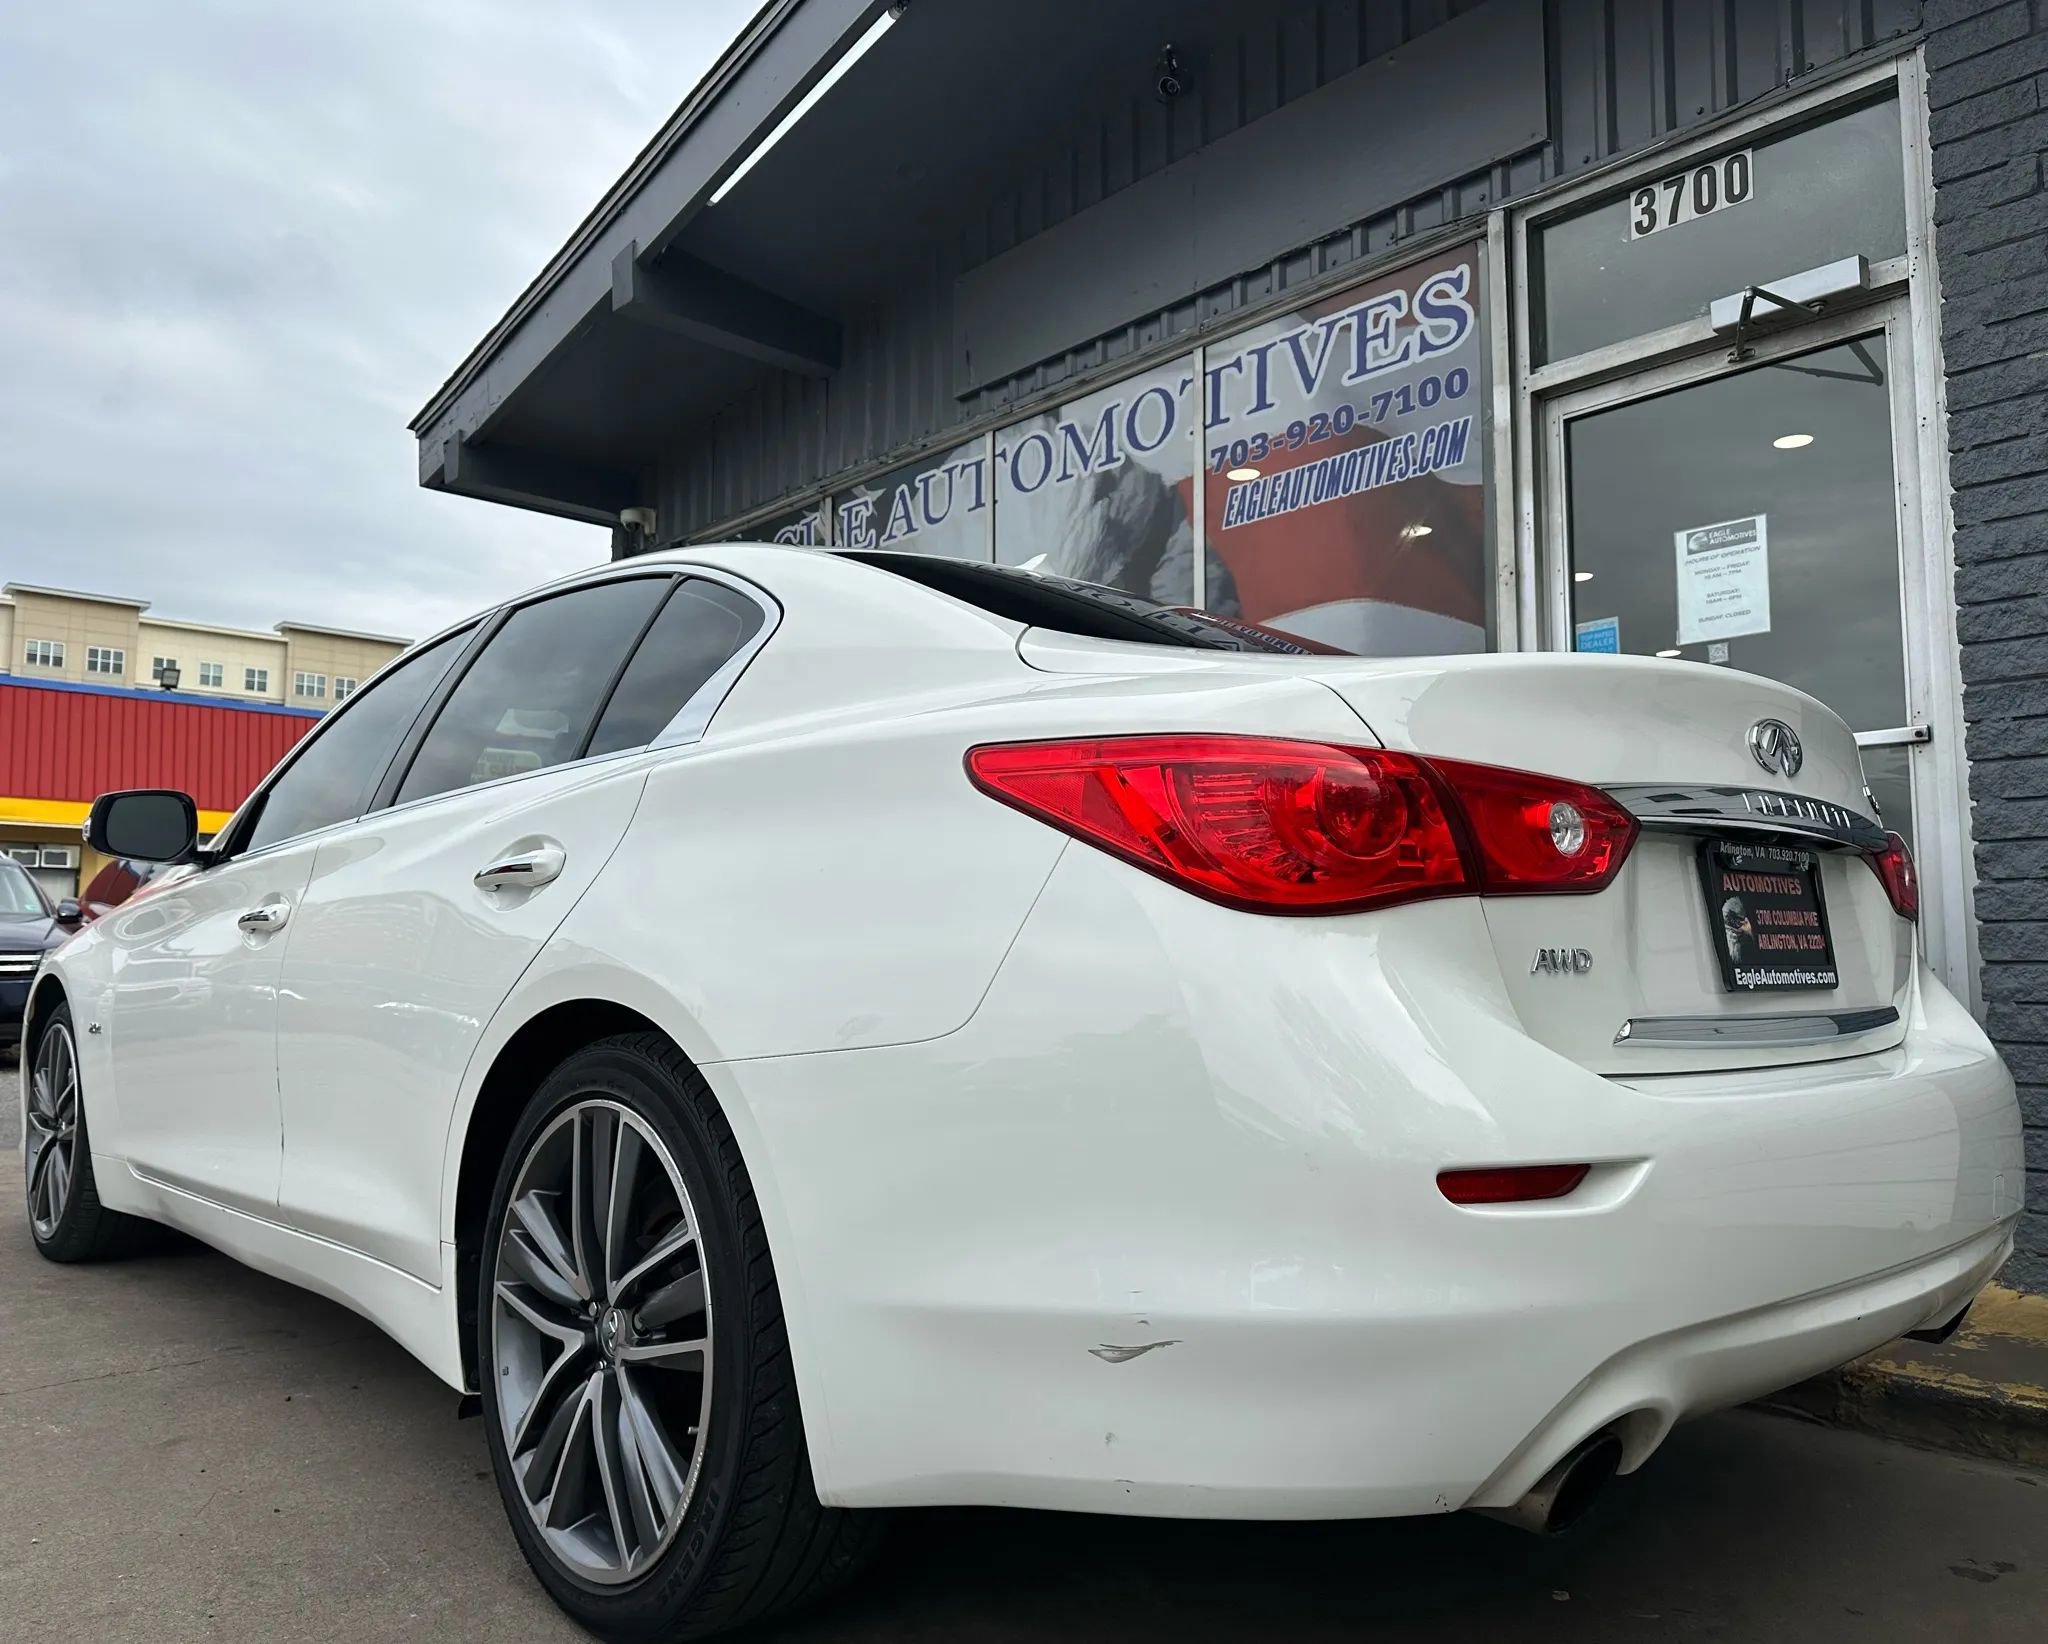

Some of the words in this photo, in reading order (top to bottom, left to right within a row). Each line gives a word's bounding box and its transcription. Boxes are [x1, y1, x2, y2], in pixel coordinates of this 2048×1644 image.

[1634, 153, 1749, 236] 3700
[882, 264, 1474, 545] AUTOMOTIVES
[1211, 367, 1470, 475] 703-920-7100
[1222, 416, 1472, 531] EAGLEAUTOMOTIVES.COM
[1719, 841, 1754, 859] Arlington,
[1754, 845, 1766, 859] VA
[1722, 873, 1802, 895] AUTOMOTIVES
[1772, 910, 1804, 926] COLUMBIA
[1758, 934, 1799, 952] ARLINGTON,
[1799, 935, 1808, 950] VA
[1530, 948, 1593, 975] AWD
[1734, 967, 1836, 989] EagleAutomotives.com
